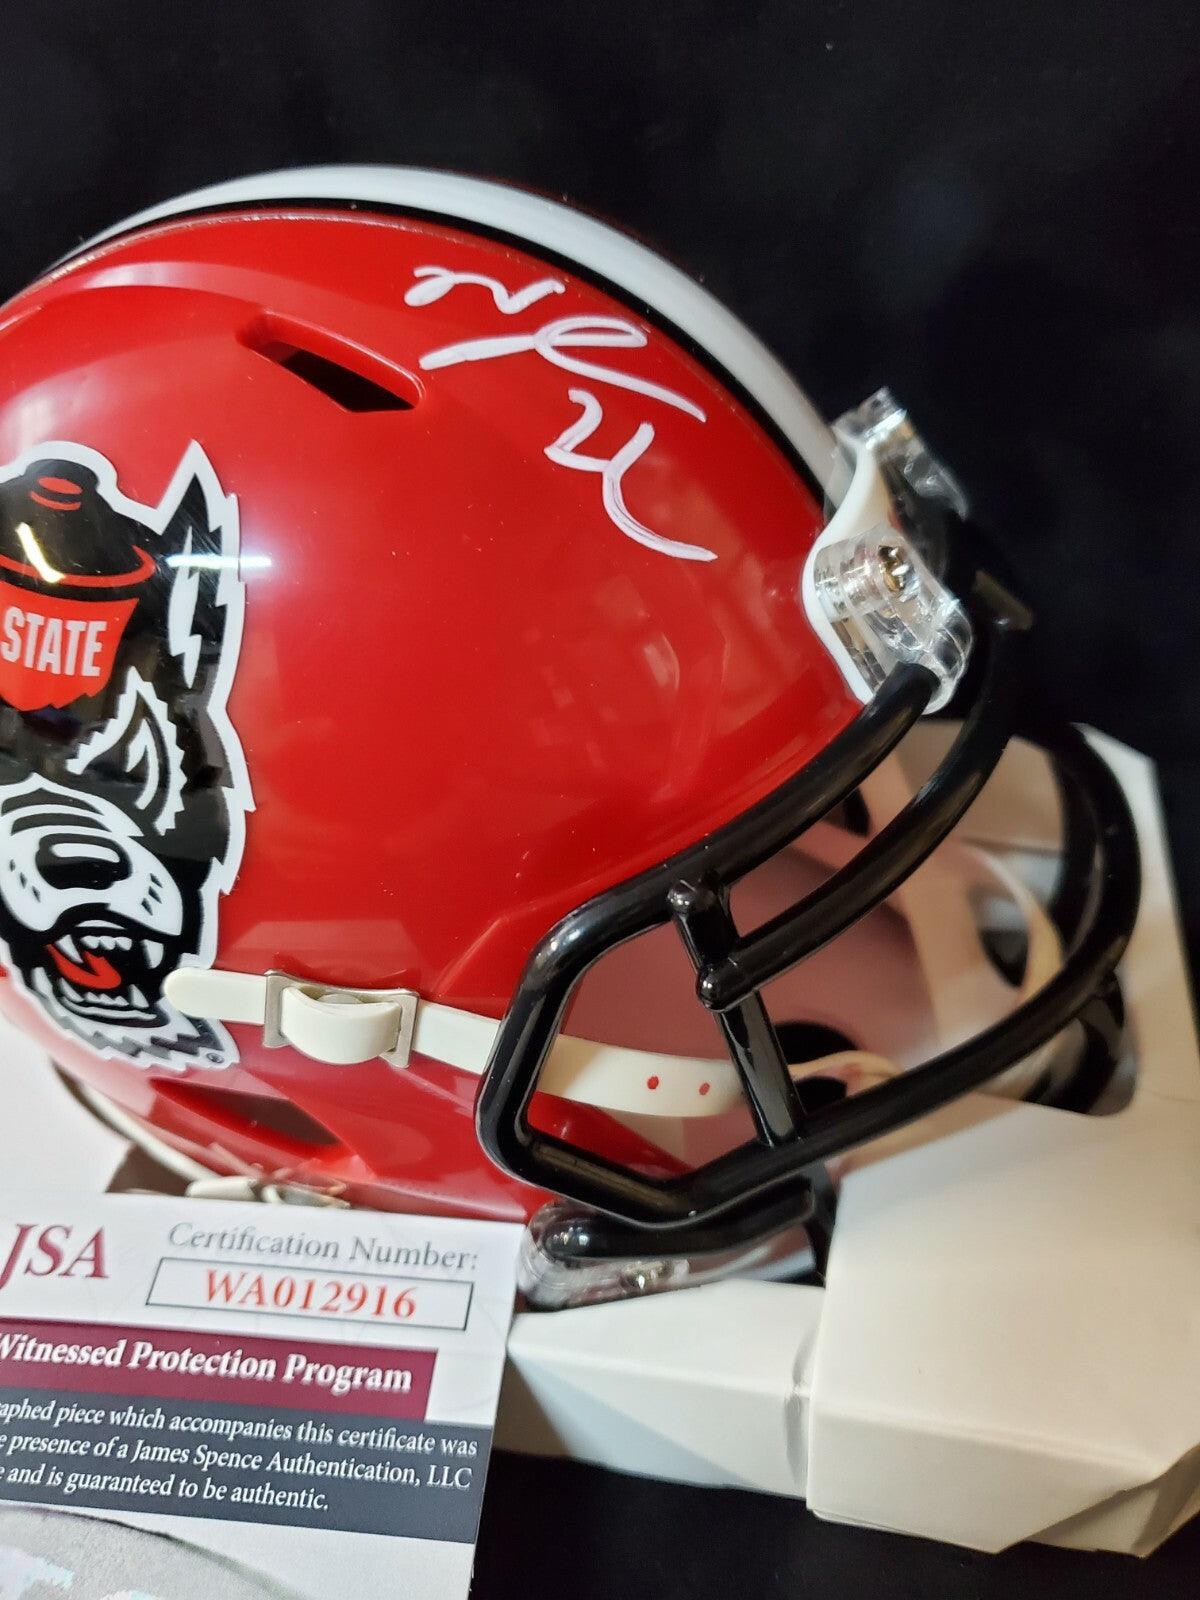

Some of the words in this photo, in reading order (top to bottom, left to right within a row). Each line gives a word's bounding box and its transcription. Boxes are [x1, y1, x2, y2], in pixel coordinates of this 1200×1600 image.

[1, 606, 107, 676] STATE
[0, 1223, 109, 1291] JSA
[169, 1221, 340, 1260] Certification
[350, 1237, 479, 1270] Number:
[206, 1268, 417, 1321] WA012916
[127, 1340, 277, 1382] Protection
[282, 1353, 413, 1397] Program
[53, 1403, 106, 1428] piece
[109, 1405, 165, 1430] which
[168, 1415, 293, 1442] accompanies
[297, 1420, 334, 1445] this
[337, 1427, 436, 1455] certificate
[440, 1438, 479, 1459] was
[6, 1435, 91, 1457] presence
[93, 1436, 120, 1459] of
[116, 1442, 128, 1458] a
[130, 1439, 190, 1464] James
[193, 1444, 263, 1472] Spence
[265, 1451, 421, 1487] Authentication,
[426, 1464, 473, 1490] LLC
[7, 1463, 47, 1485] and
[46, 1466, 65, 1486] is
[63, 1473, 176, 1496] guaranteed
[178, 1480, 199, 1499] to
[202, 1477, 229, 1501] be
[230, 1482, 330, 1510] authentic.
